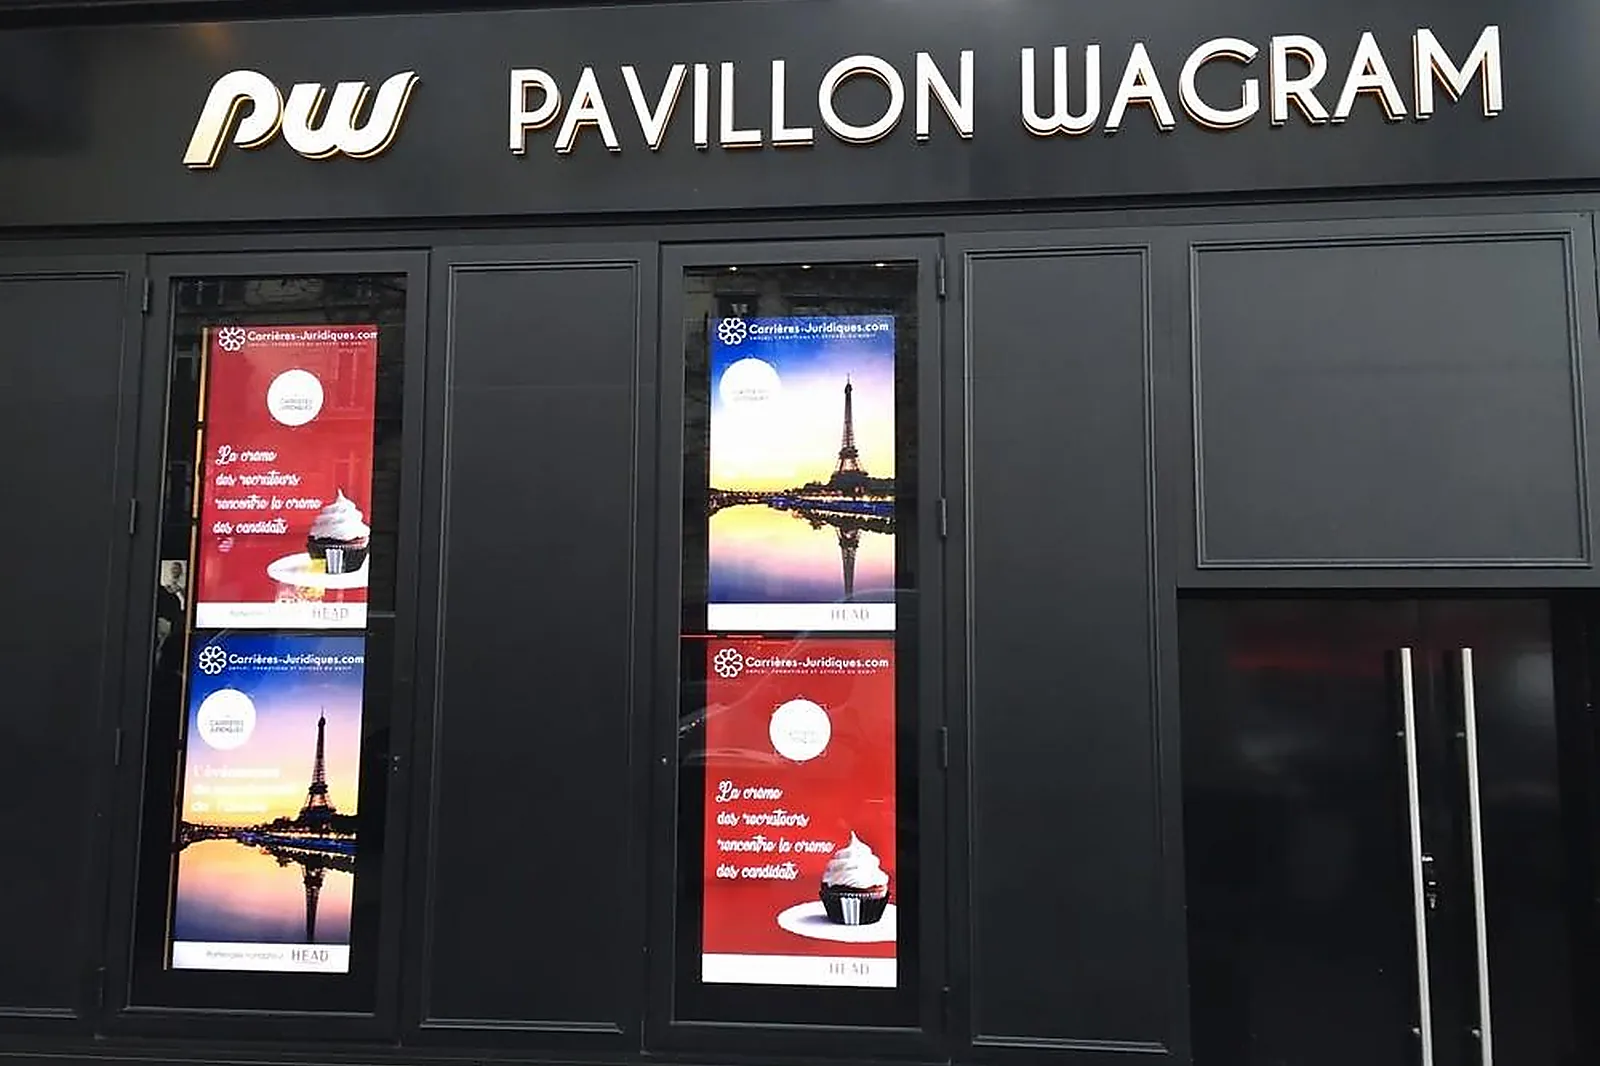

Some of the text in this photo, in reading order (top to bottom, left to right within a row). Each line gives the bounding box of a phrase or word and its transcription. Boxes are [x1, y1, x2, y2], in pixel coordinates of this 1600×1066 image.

[508, 25, 1504, 155] PAVILLON WAGRAM
[215, 444, 237, 466] La
[215, 473, 237, 486] des
[271, 496, 284, 510] la
[212, 517, 289, 535] des candidats
[745, 656, 889, 670] Carrières-Juridiques.com
[716, 780, 741, 803] La
[717, 811, 740, 827] des
[778, 836, 793, 853] la
[716, 862, 799, 880] des candidats
[291, 949, 329, 963] HEAD
